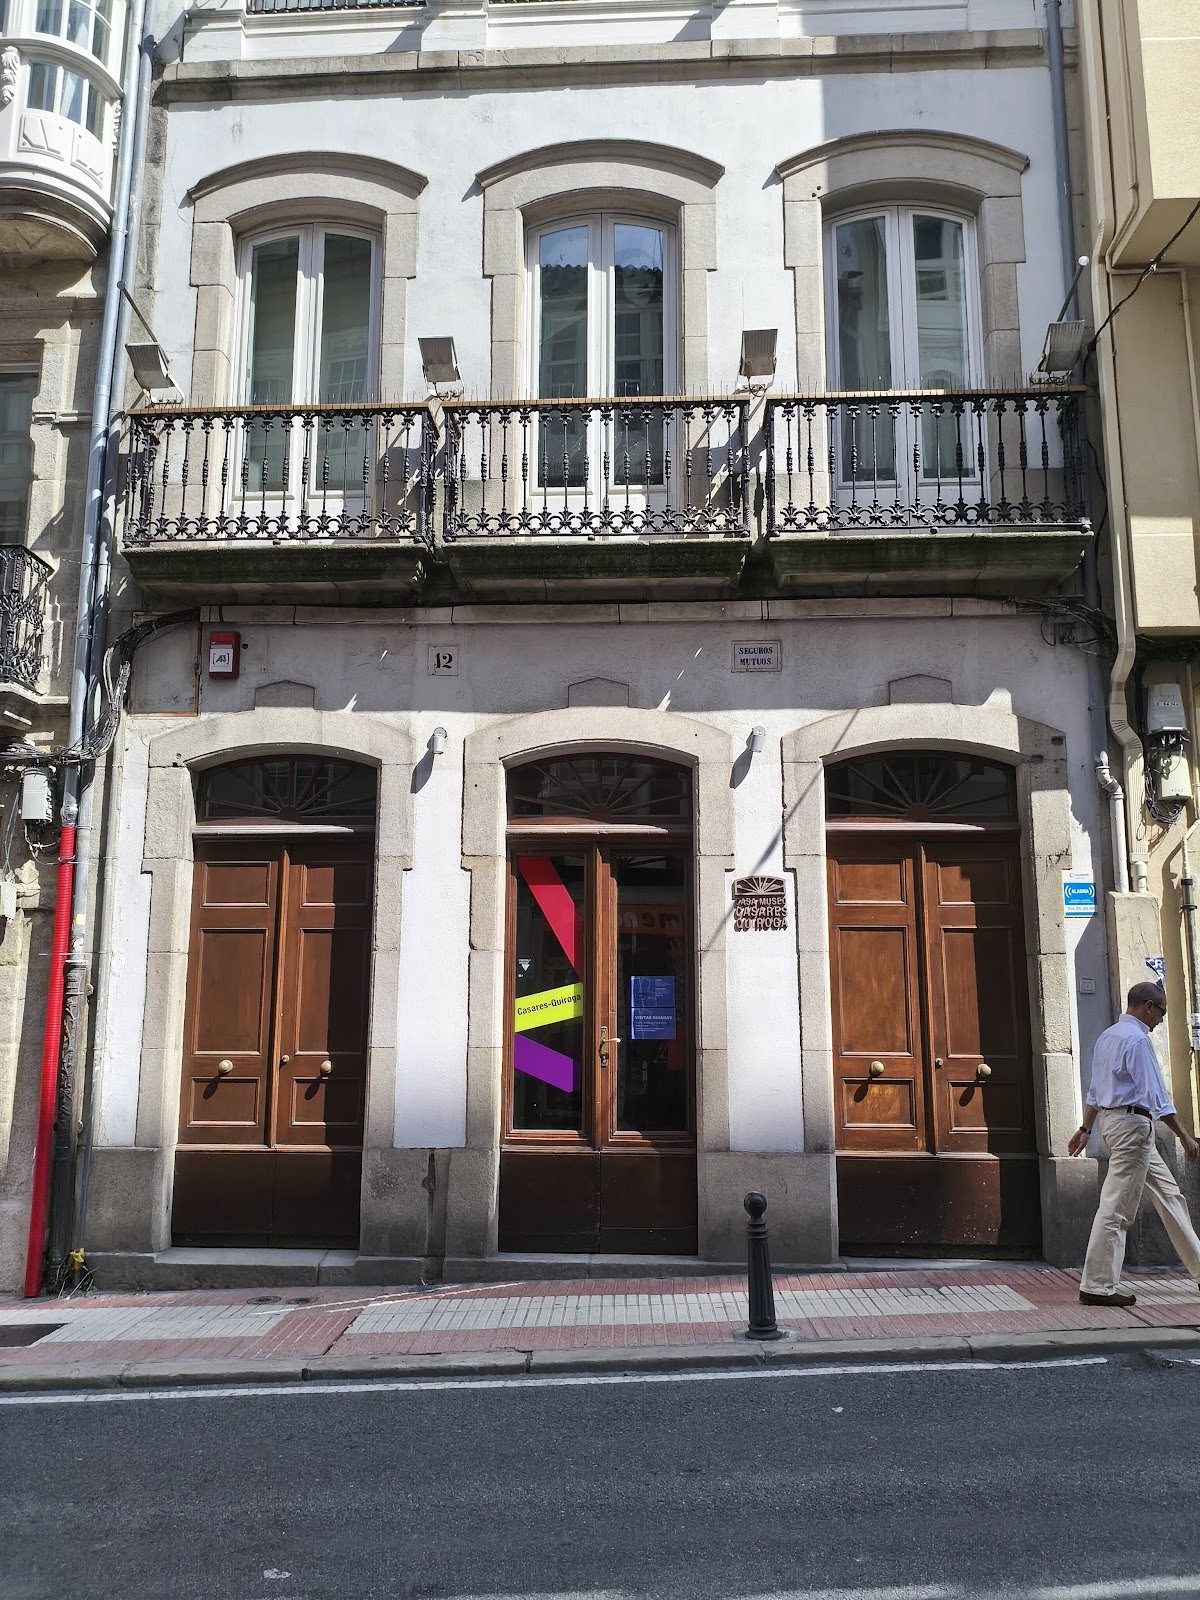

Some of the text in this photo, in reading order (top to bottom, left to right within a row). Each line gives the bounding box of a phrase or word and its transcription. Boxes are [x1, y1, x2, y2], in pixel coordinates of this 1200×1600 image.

[738, 646, 773, 655] SEGUROS
[435, 652, 453, 669] 12
[739, 657, 772, 666] MUTUOS
[759, 897, 786, 906] MUSEO
[736, 906, 788, 917] CASARES
[736, 917, 788, 929] QUIROGA
[517, 994, 582, 1016] Casares-Quiroga
